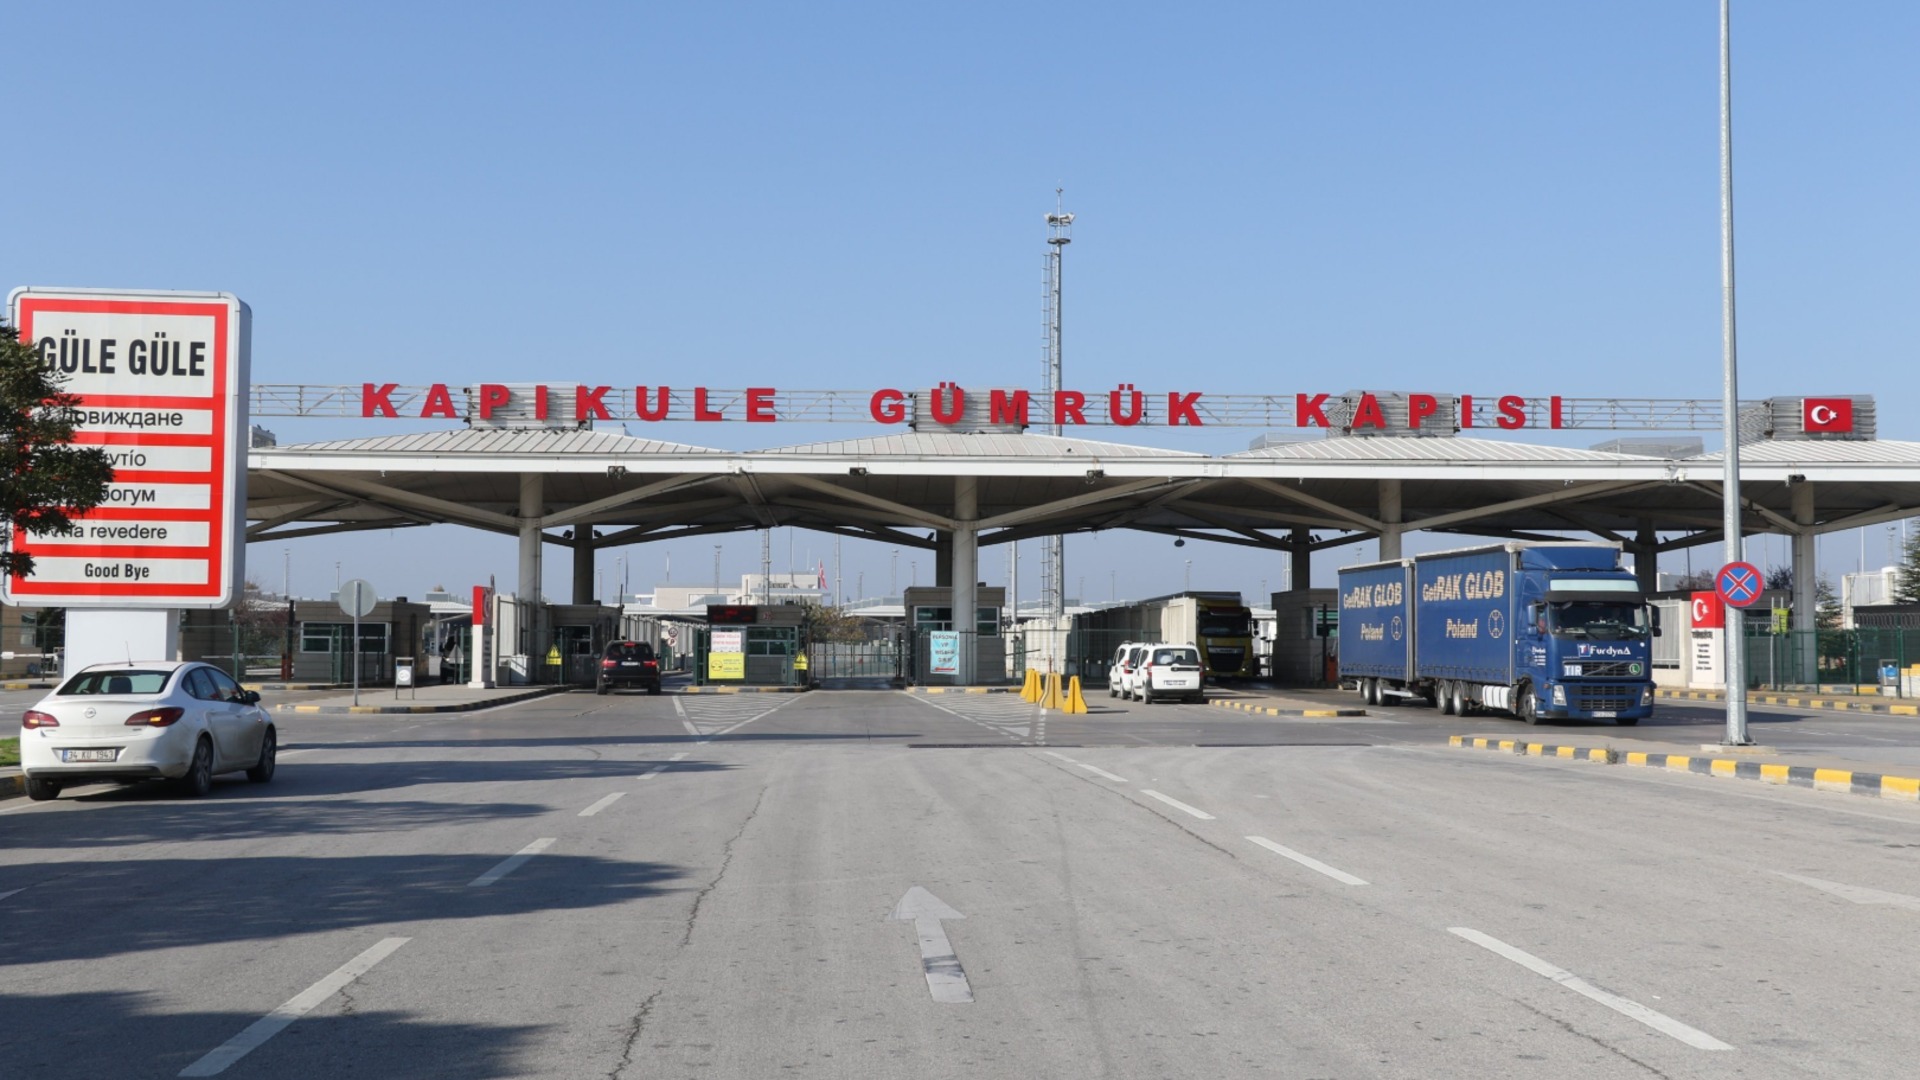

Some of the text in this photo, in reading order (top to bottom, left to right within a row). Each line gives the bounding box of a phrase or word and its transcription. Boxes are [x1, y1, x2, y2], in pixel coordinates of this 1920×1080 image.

[38, 329, 206, 377] GÜLE GÜLE
[362, 382, 1562, 430] KAPIKULE GÜMRÜK KAPISI
[90, 524, 168, 540] revedere
[85, 563, 150, 581] Good Bye
[1374, 582, 1402, 607] GLOB
[1465, 570, 1504, 599] GLOB
[1361, 623, 1384, 640] Poland
[1446, 618, 1478, 638] Poland
[1564, 665, 1582, 676] TIR
